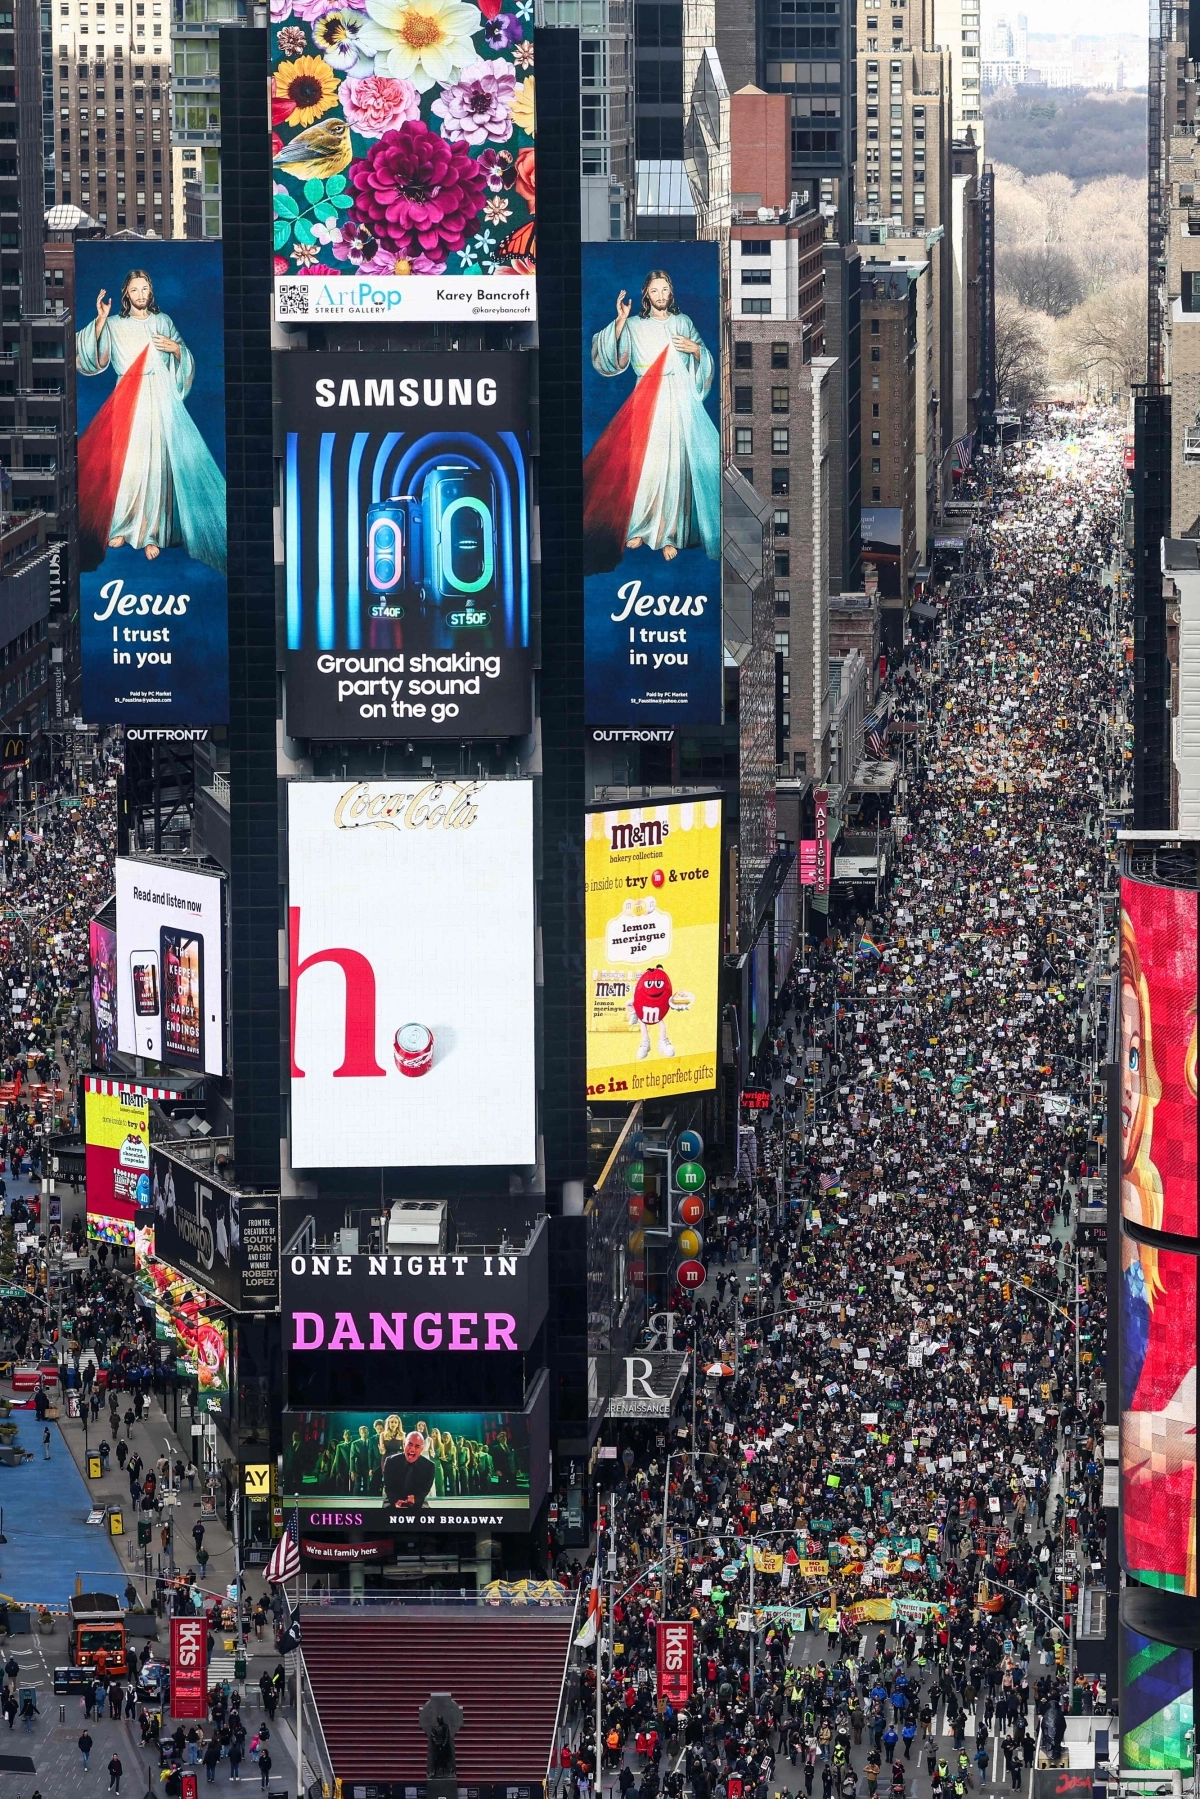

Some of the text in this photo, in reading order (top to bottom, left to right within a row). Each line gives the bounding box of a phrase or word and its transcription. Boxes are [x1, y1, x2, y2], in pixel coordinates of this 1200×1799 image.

[315, 283, 402, 311] ArtPop
[436, 289, 530, 303] Karey Bancroft
[471, 306, 531, 315] @kareybancroft
[315, 377, 497, 408] SAMSUNG
[93, 579, 190, 622] Jesus
[610, 579, 708, 622] Jesus
[372, 607, 401, 618] ST40F
[450, 612, 487, 625] ST50F
[113, 626, 170, 642] I trust
[629, 627, 687, 643] I trust
[113, 648, 172, 669] in you
[317, 652, 501, 679] Ground shaking
[629, 649, 689, 670] in you
[338, 676, 480, 702] party sound
[360, 701, 459, 723] on the go
[609, 851, 663, 863] bakery collection
[590, 876, 614, 892] inside
[615, 877, 624, 889] to
[625, 875, 648, 889] try
[668, 869, 678, 882] &
[680, 867, 709, 881] vote
[133, 886, 202, 913] Read and listen now
[622, 922, 656, 933] lemon
[612, 932, 666, 945] meringue
[175, 946, 189, 958] THE
[630, 944, 647, 954] pie
[169, 964, 195, 979] KEEPER
[177, 985, 187, 996] OF
[170, 1004, 194, 1018] HAPPY
[166, 1020, 200, 1038] ENDINGS
[607, 1077, 628, 1093] in
[632, 1074, 645, 1089] for
[645, 1071, 661, 1087] the
[661, 1068, 692, 1089] perfect
[693, 1064, 714, 1084] gifts
[127, 1120, 138, 1129] try
[685, 1173, 697, 1183] m
[690, 1206, 700, 1216] m
[248, 1219, 271, 1227] FROM THE
[243, 1227, 276, 1236] CREATORS OF
[243, 1235, 276, 1244] SOUTH
[247, 1244, 272, 1252] PARK
[247, 1253, 271, 1261] AND EGOT
[249, 1261, 270, 1269] WINNER
[290, 1256, 518, 1276] ONE NIGHT IN
[242, 1270, 278, 1278] ROBERT
[686, 1270, 698, 1281] m
[246, 1278, 275, 1286] LOPEZ
[292, 1311, 518, 1350] DANGER
[622, 1357, 667, 1399] R
[611, 1404, 670, 1413] RENAISSANCE
[310, 1512, 505, 1526] CHESS NOW ON BROADWAY
[305, 1544, 322, 1556] We're
[322, 1546, 333, 1556] all
[334, 1546, 359, 1558] family
[179, 1621, 201, 1666] tkts
[665, 1626, 688, 1671] tkts
